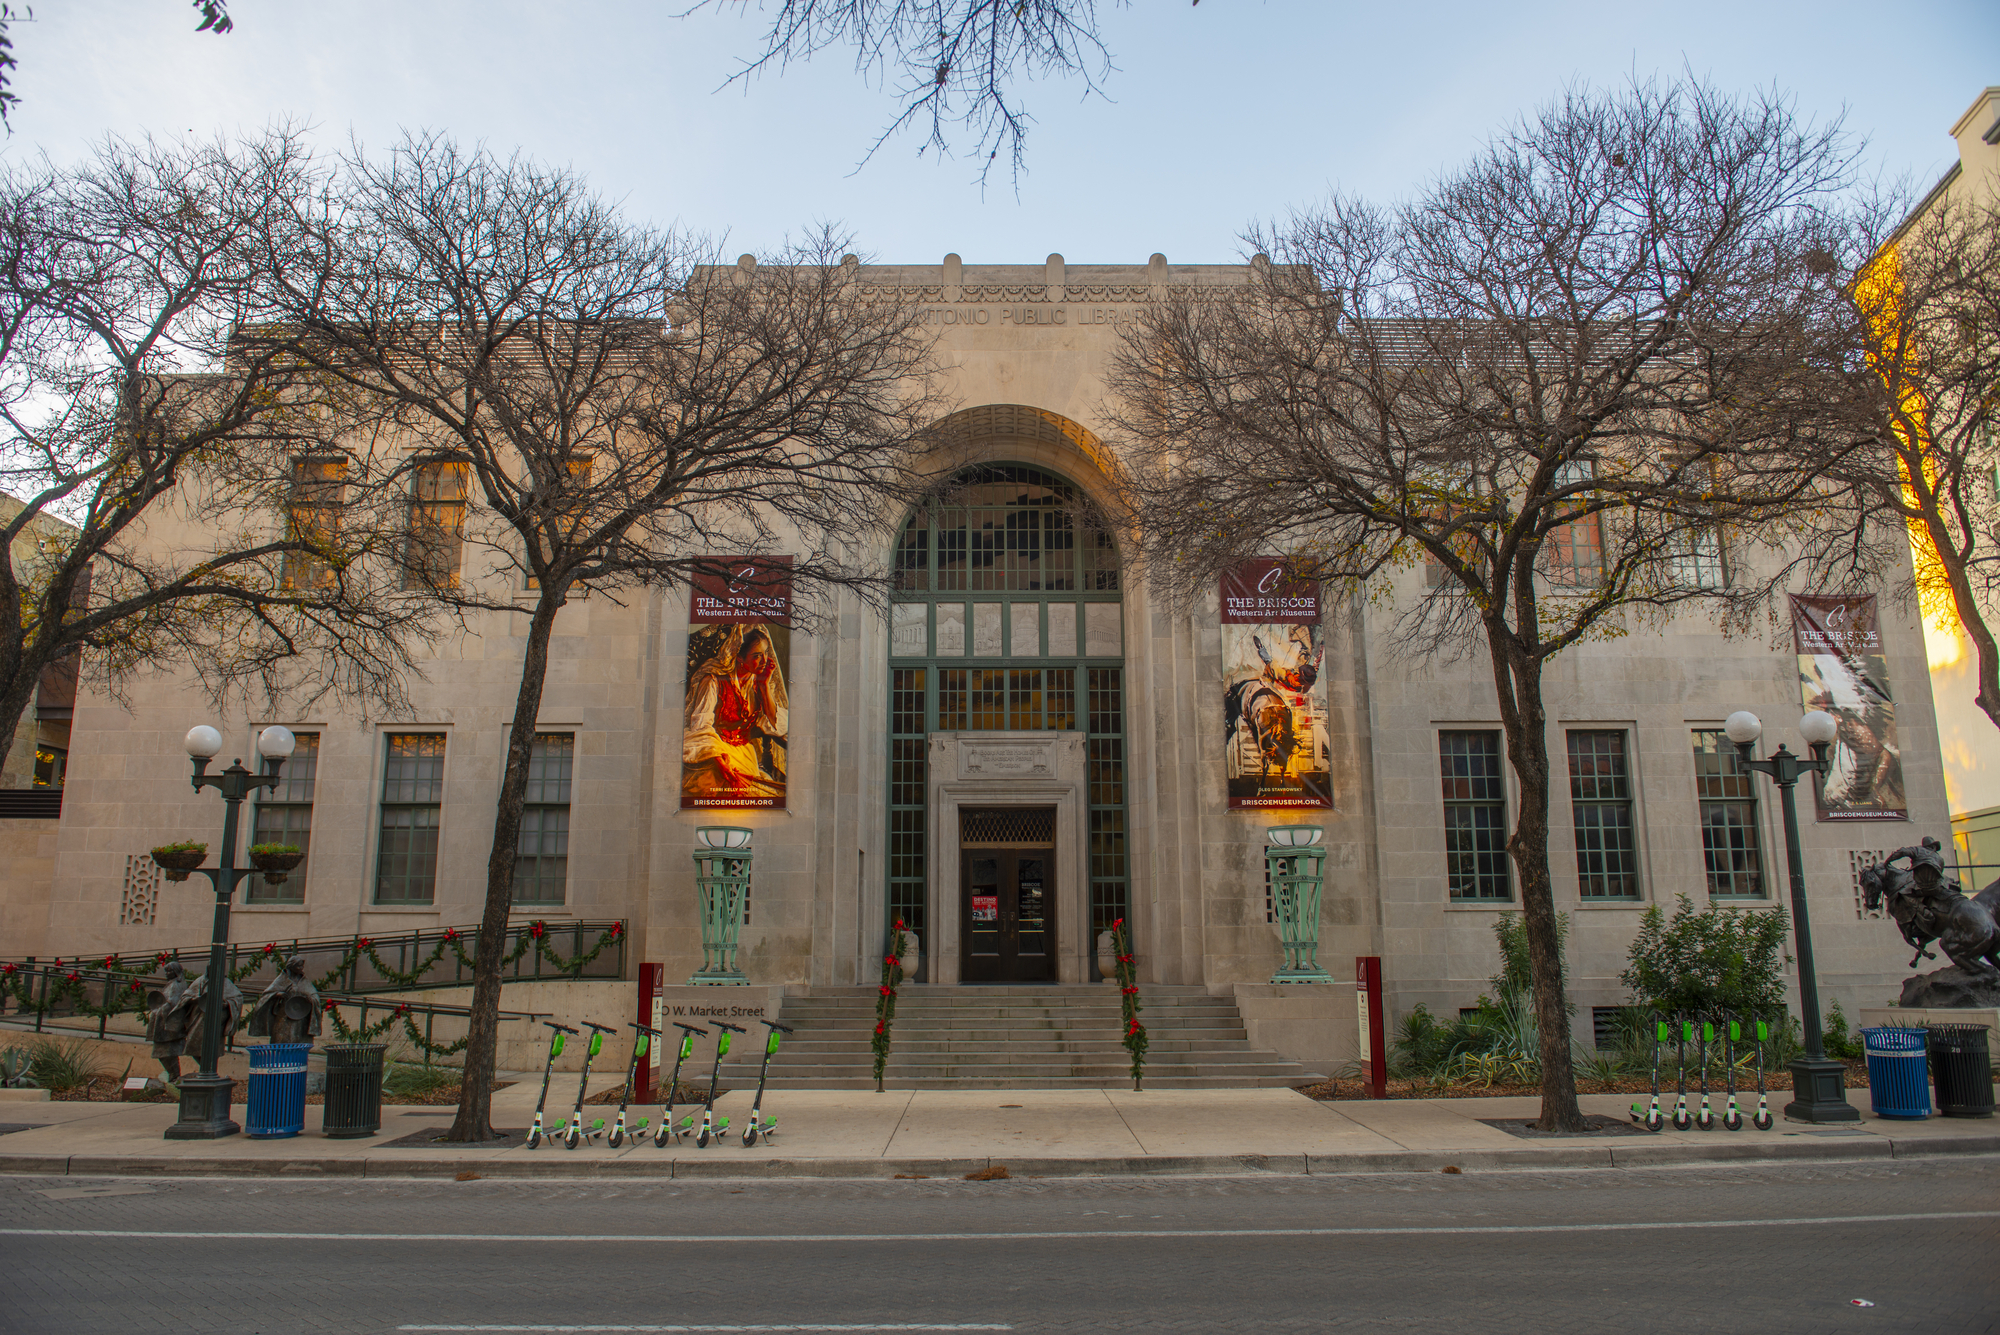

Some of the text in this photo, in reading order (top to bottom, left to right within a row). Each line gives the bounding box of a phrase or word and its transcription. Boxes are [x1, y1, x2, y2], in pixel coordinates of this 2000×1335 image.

[1000, 308, 1065, 325] PUBLIC
[1077, 308, 1148, 325] LIBRAR
[697, 597, 724, 608] THE
[1227, 597, 1316, 608] THE BRISCOE
[696, 608, 732, 617] Western
[733, 608, 747, 617] Art
[1227, 608, 1316, 617] Western Art Museum
[1800, 630, 1825, 640] THE
[1802, 640, 1833, 648] Western
[673, 1006, 686, 1016] W.
[690, 1005, 728, 1016] Market
[730, 1005, 765, 1016] Street
